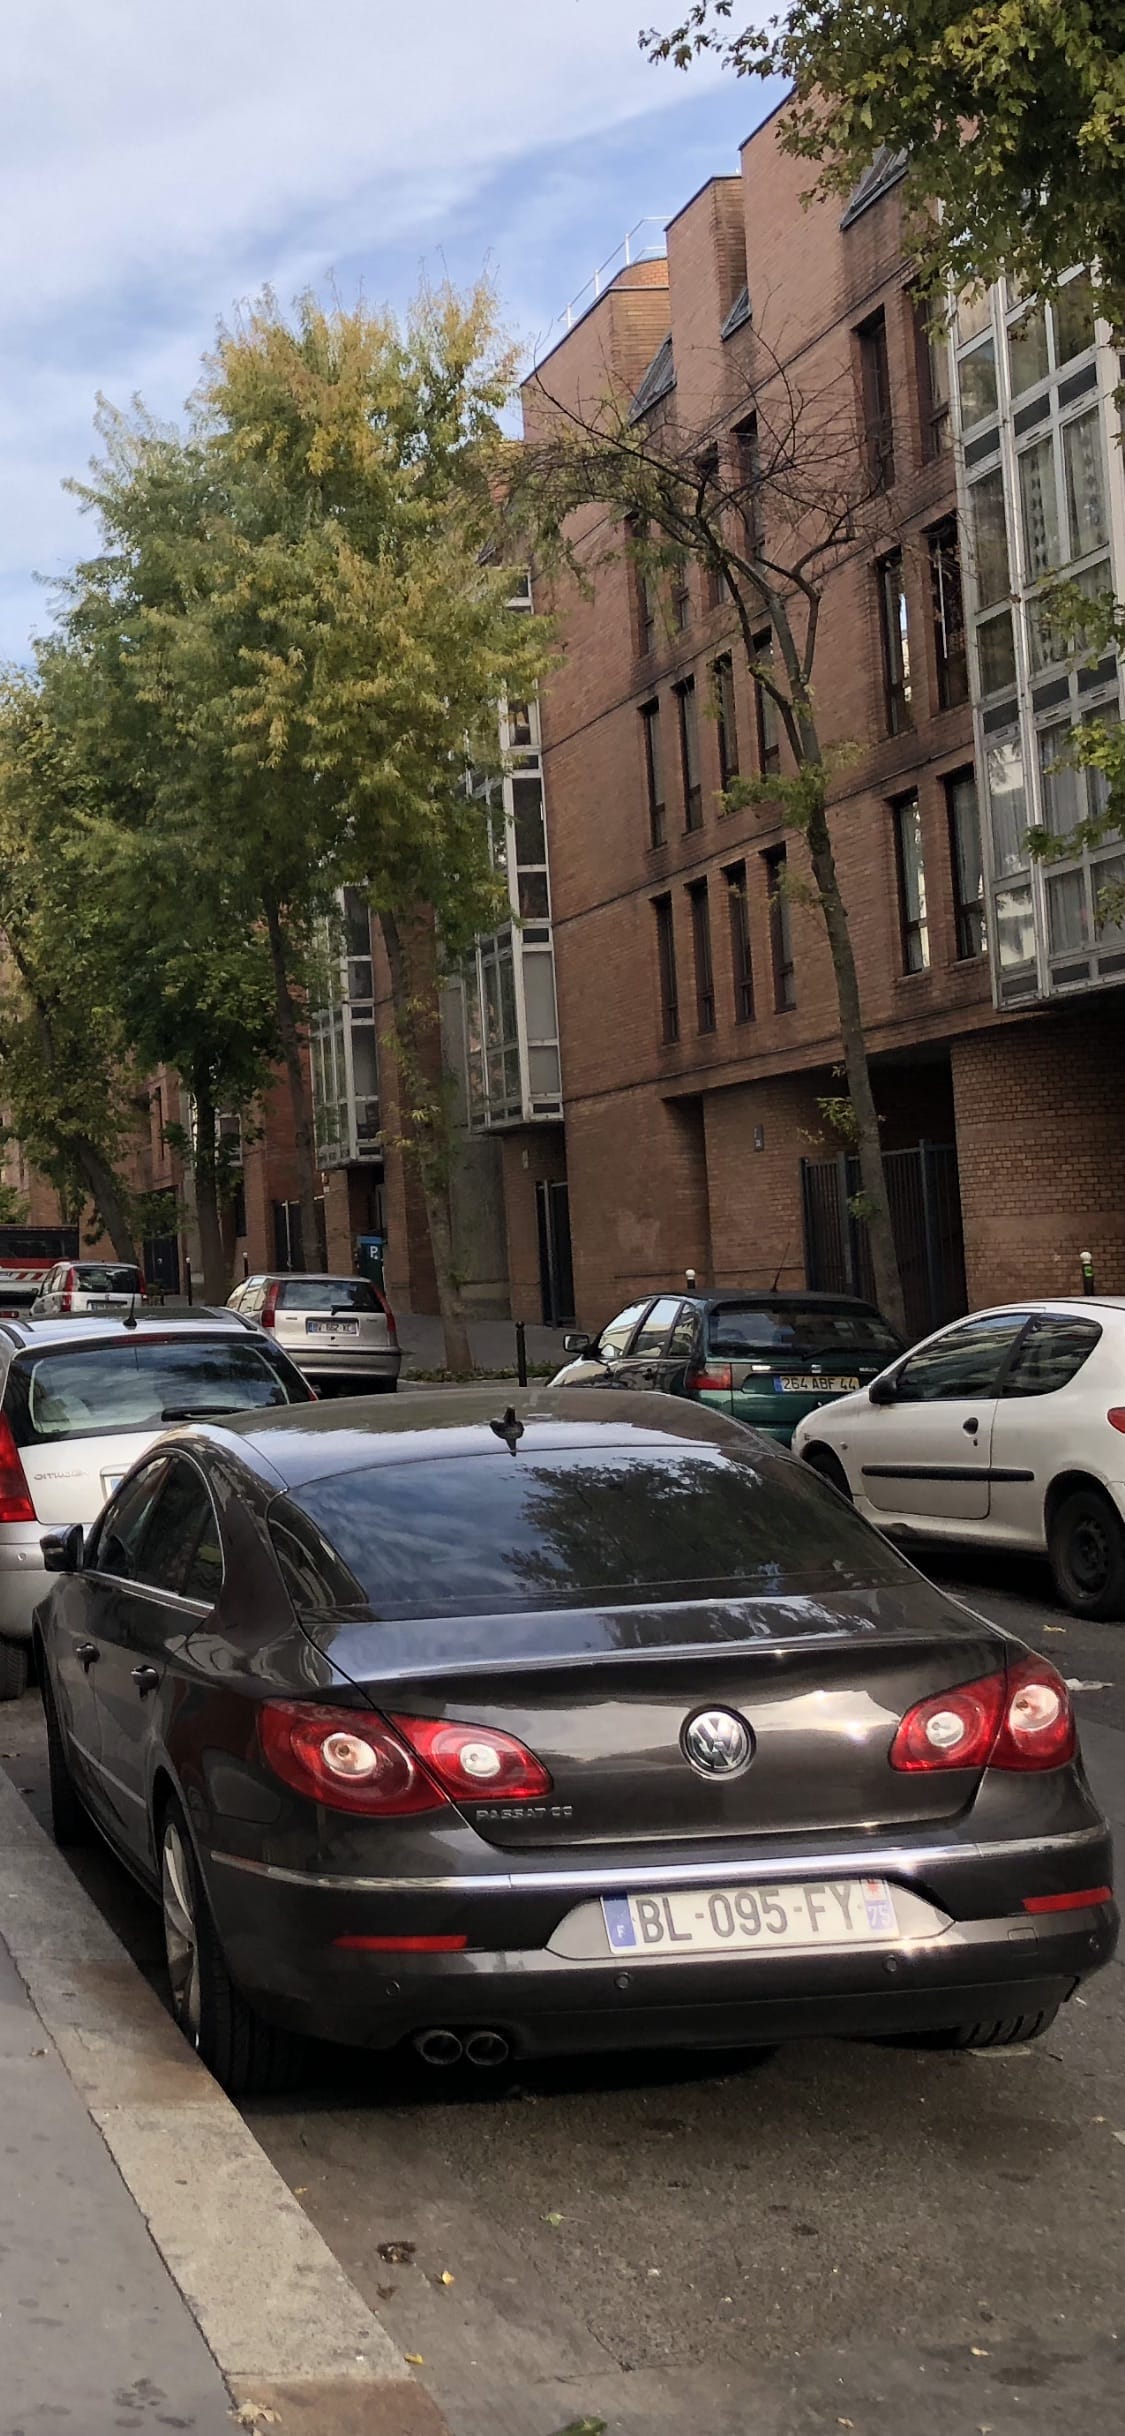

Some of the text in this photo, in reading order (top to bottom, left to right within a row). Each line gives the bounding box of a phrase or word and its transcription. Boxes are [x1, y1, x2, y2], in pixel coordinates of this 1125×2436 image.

[783, 1375, 857, 1391] 264 ABF 44
[475, 1807, 546, 1821] PASSAT
[867, 1904, 889, 1926] 75
